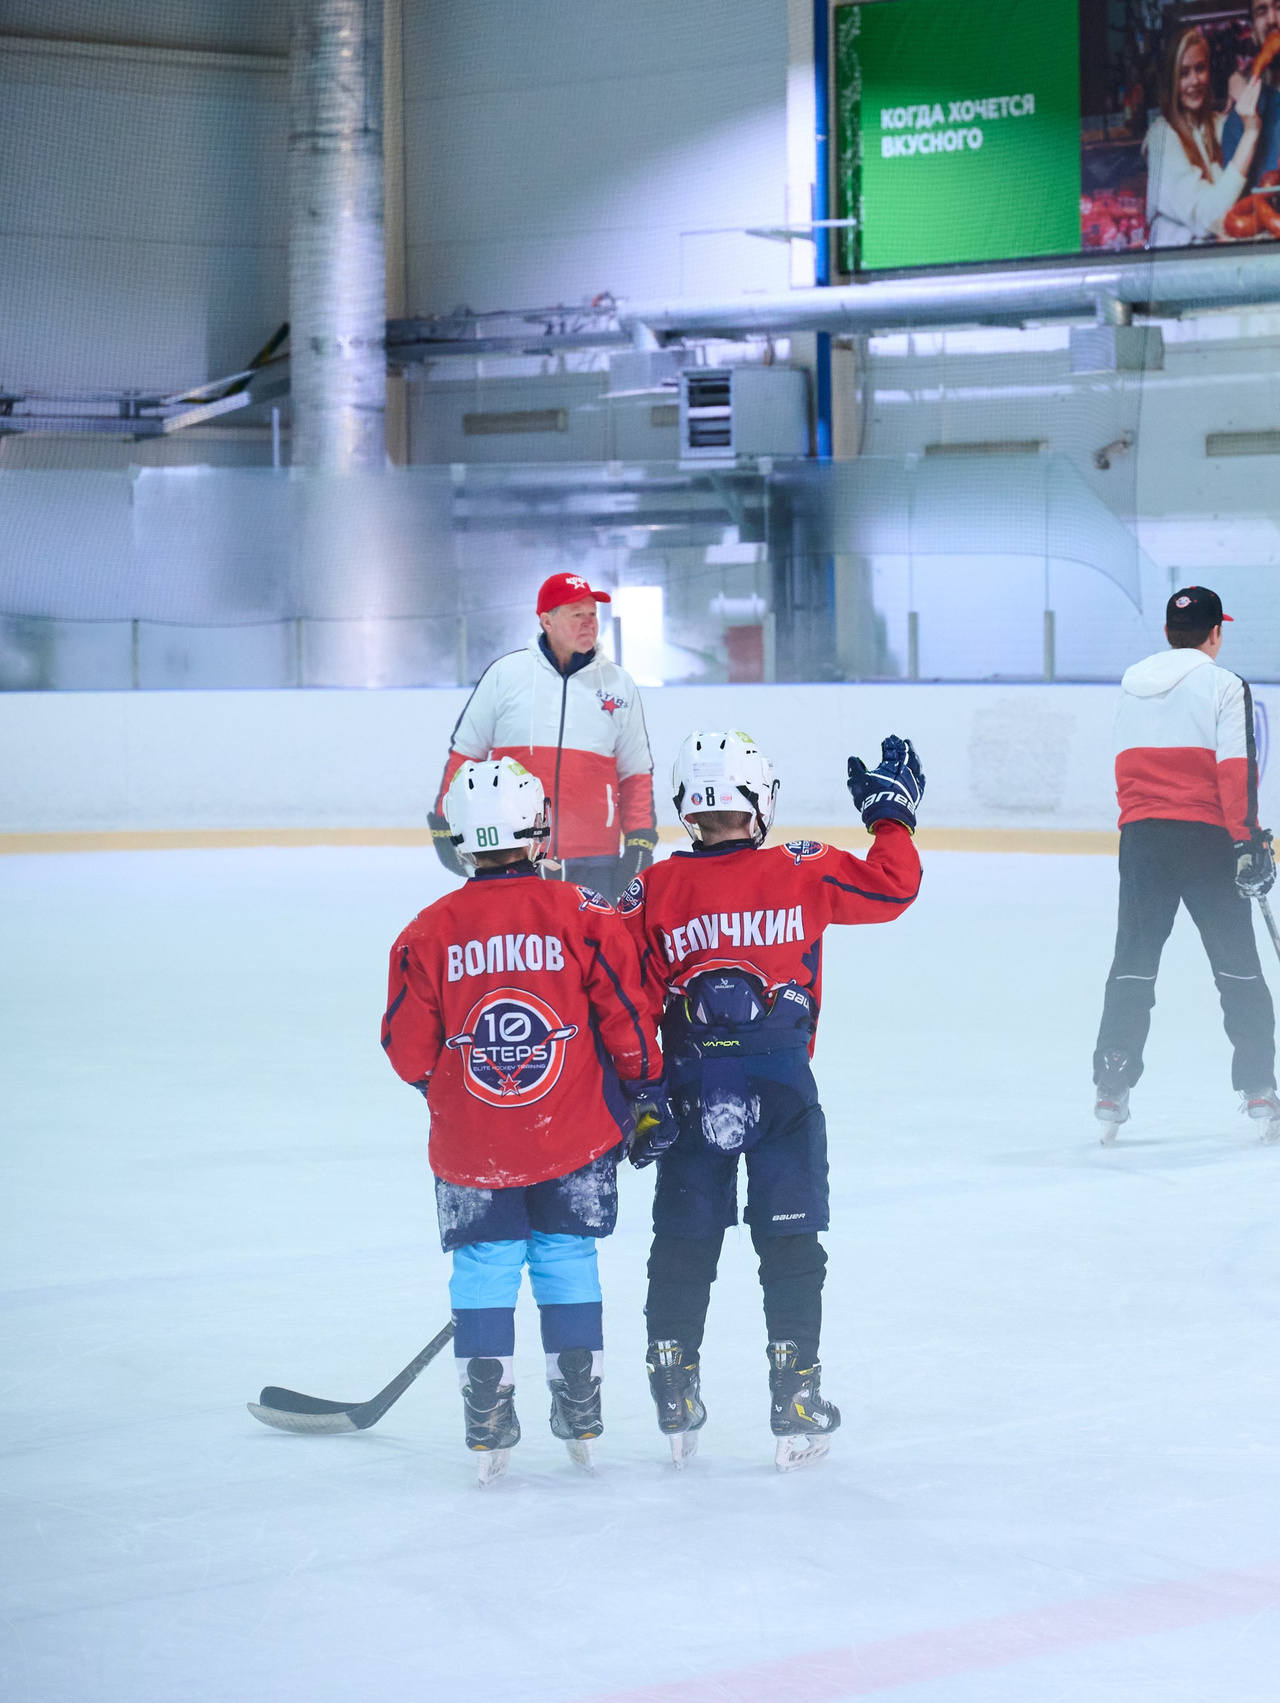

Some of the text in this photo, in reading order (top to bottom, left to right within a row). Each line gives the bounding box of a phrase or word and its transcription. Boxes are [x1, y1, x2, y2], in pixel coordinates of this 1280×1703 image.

[880, 93, 1035, 131] КОГДА ХОЧЕТСЯ
[881, 127, 983, 159] ВКУСНОГО
[705, 786, 716, 807] 8
[476, 826, 499, 847] 80
[447, 934, 565, 982] ВОЛКОВ
[484, 1012, 532, 1042] 10
[472, 1045, 547, 1063] STEPS
[492, 1064, 516, 1072] HOCKEY
[771, 1213, 806, 1222] BAUER
